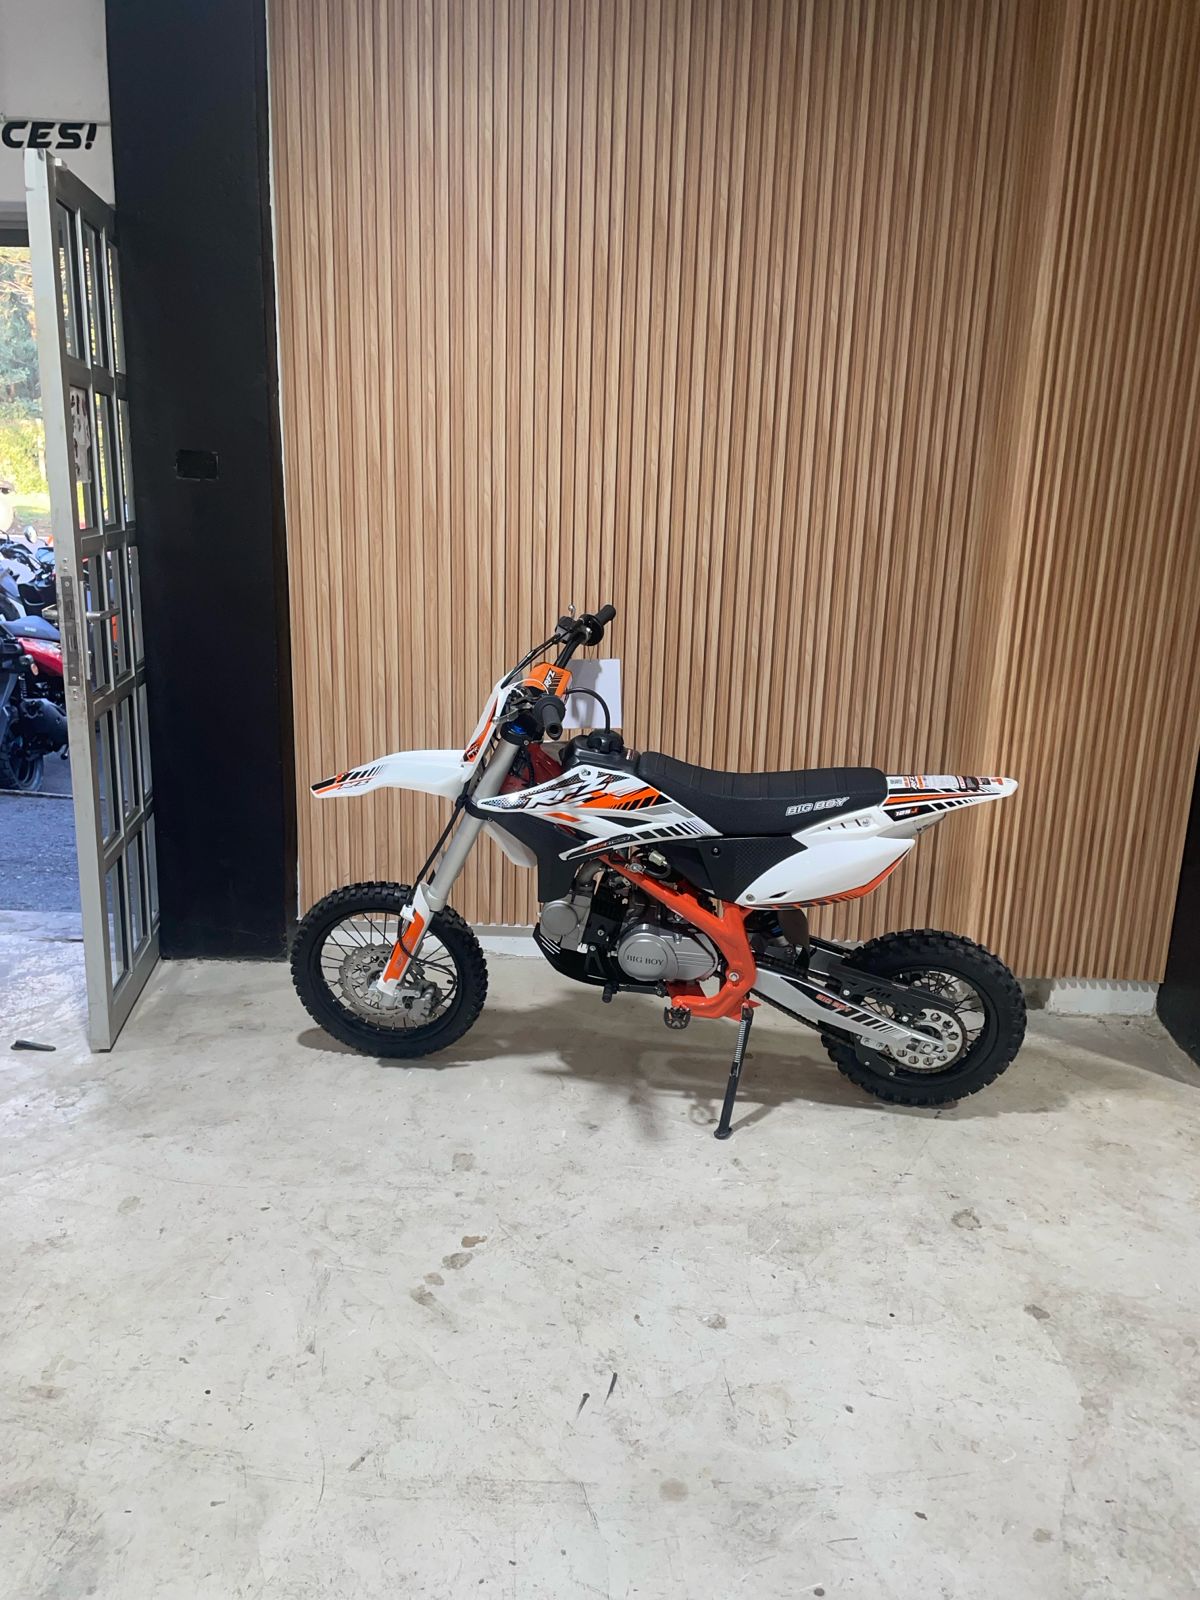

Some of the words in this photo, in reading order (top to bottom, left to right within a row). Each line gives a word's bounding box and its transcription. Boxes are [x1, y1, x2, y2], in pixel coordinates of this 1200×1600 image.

[1, 121, 97, 150] CES!
[785, 802, 814, 817] BIG
[812, 796, 850, 811] BOY
[626, 955, 643, 964] BIG
[645, 958, 664, 966] BOY
